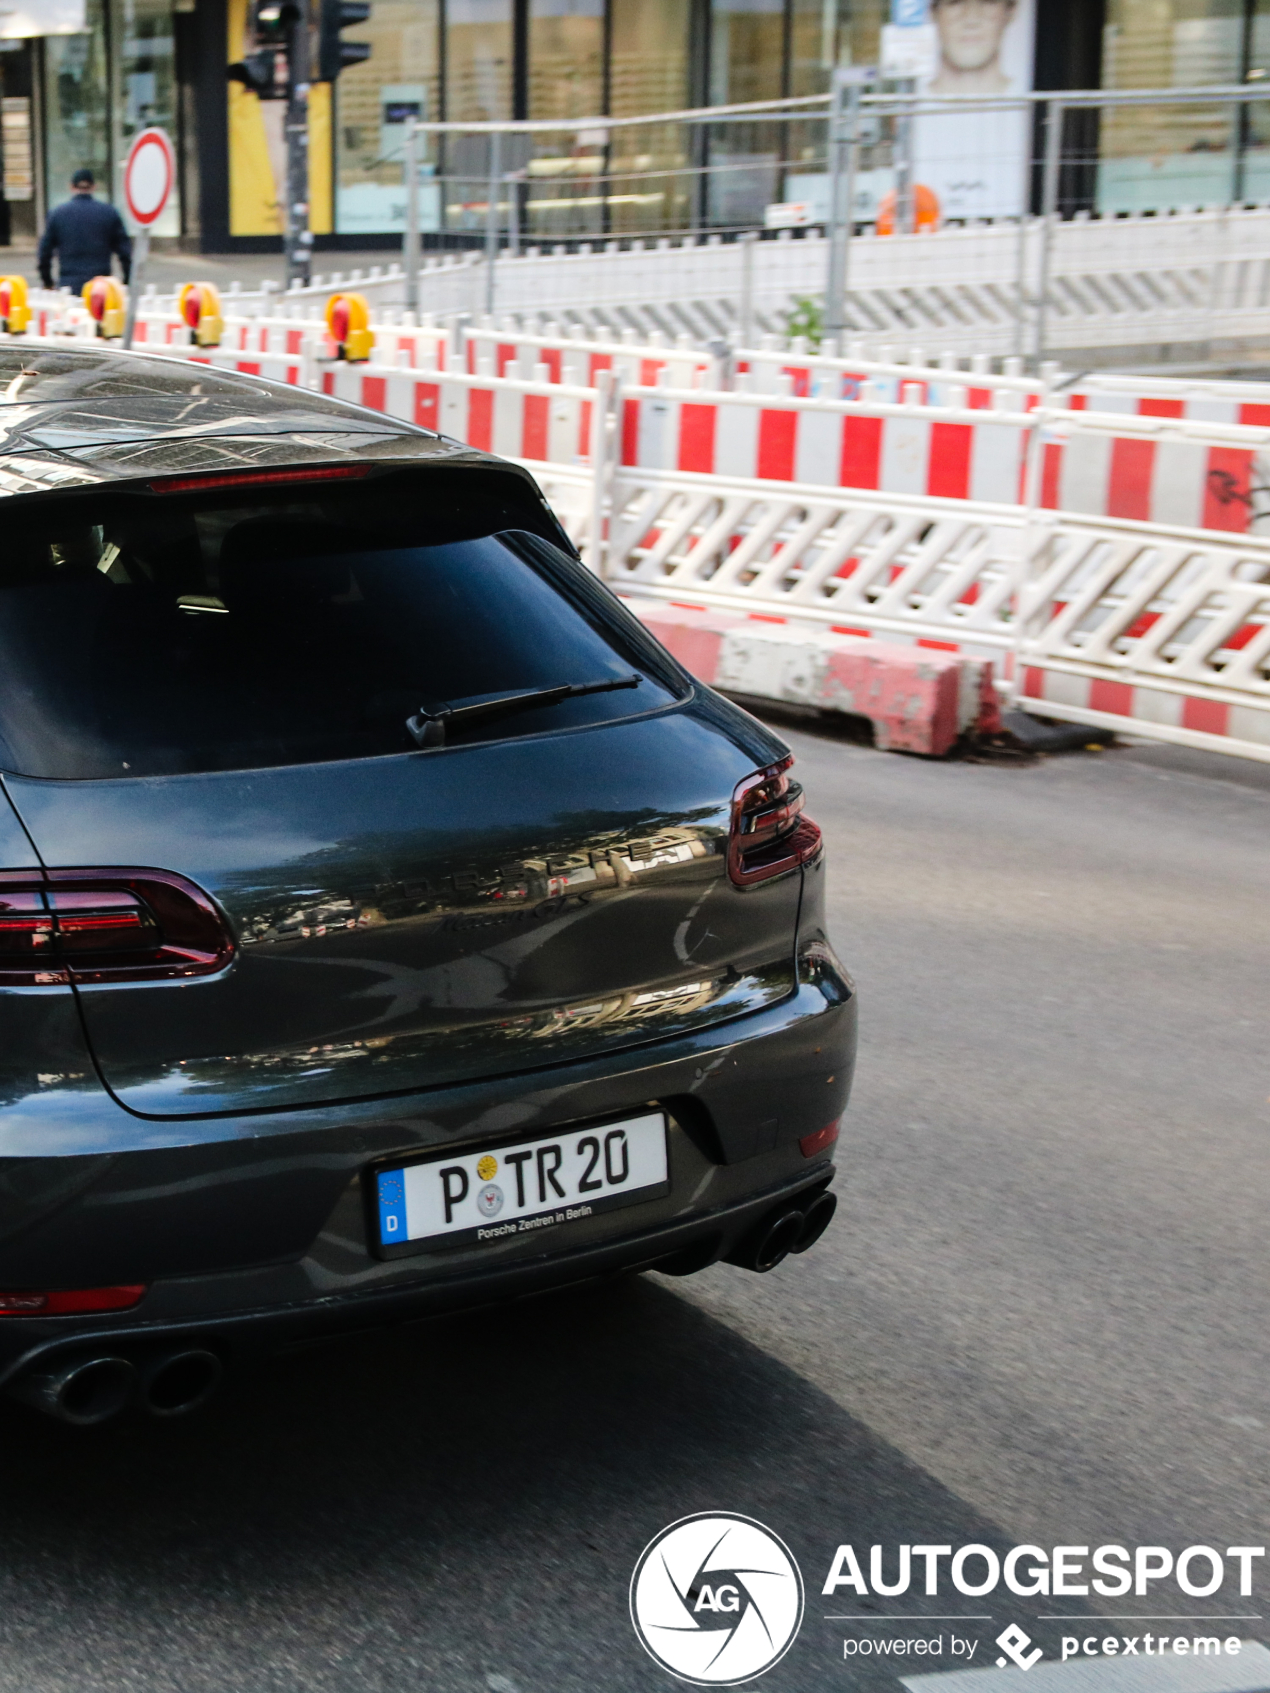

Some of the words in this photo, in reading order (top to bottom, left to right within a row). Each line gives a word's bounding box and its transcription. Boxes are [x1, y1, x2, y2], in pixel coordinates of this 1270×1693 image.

[439, 1166, 469, 1223] P
[505, 1144, 566, 1208] TR
[578, 1130, 629, 1193] 20
[386, 1215, 398, 1232] D
[477, 1222, 517, 1240] Porsche
[518, 1214, 555, 1231] Zentren
[556, 1211, 566, 1223] in
[566, 1205, 593, 1220] Berlin
